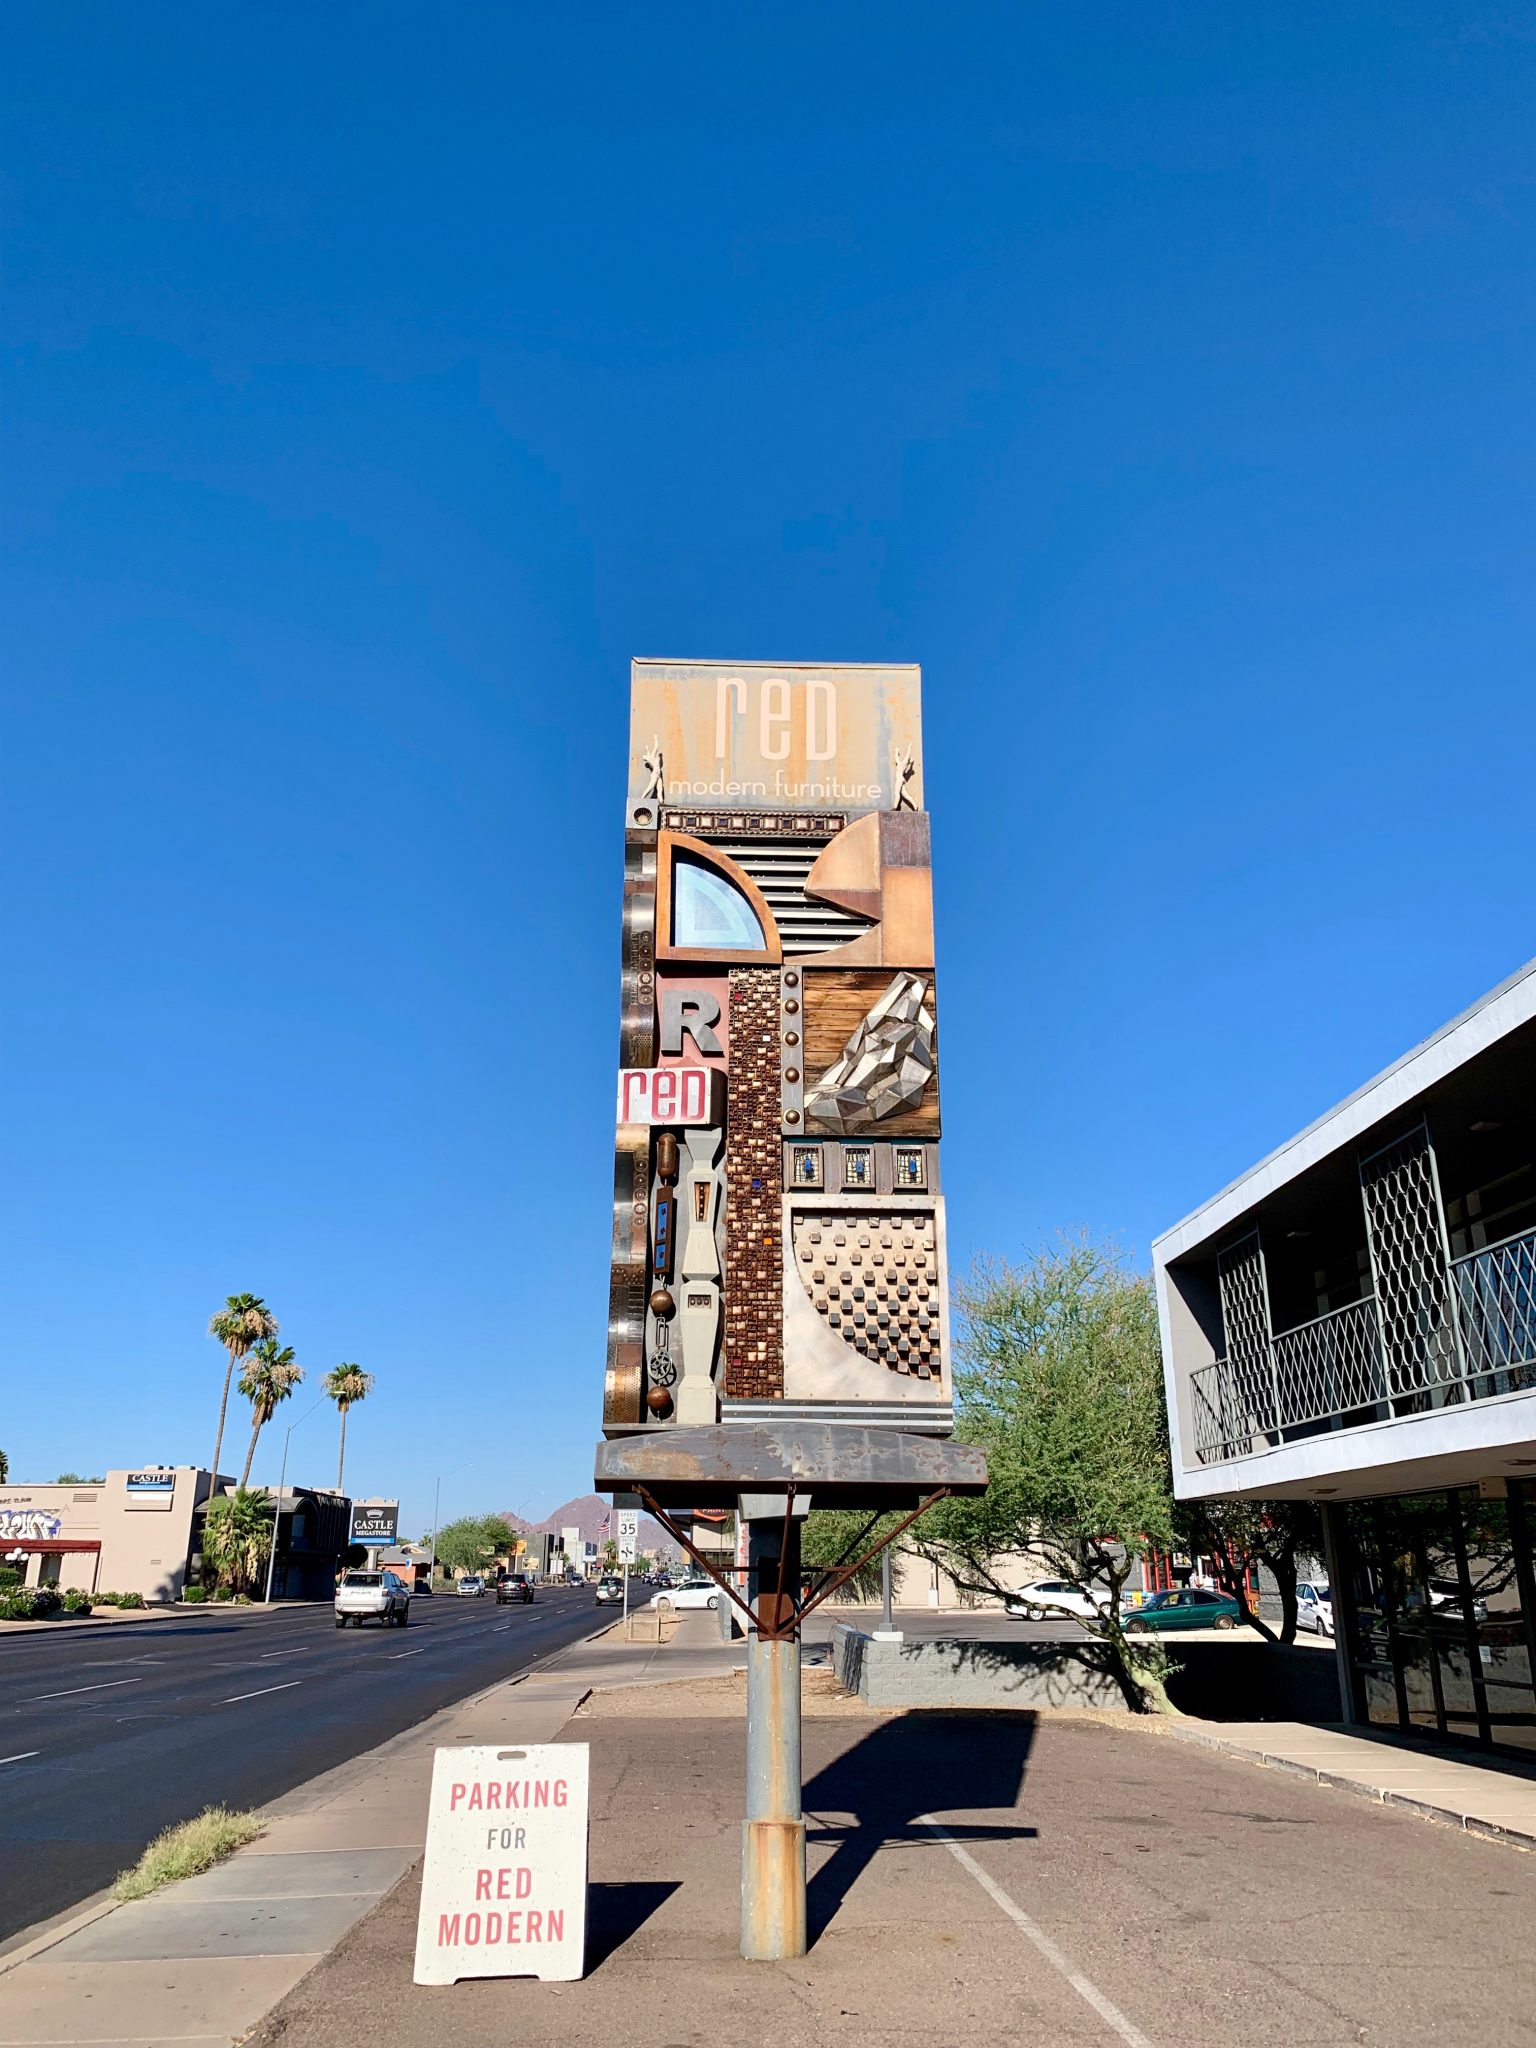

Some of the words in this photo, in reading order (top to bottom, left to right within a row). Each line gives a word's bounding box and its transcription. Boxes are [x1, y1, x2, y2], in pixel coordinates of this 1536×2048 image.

[669, 768, 766, 796] modern
[774, 769, 882, 798] furniture
[661, 990, 724, 1053] R
[132, 1474, 169, 1482] CASTLE
[354, 1519, 394, 1530] CASTLE
[620, 1523, 636, 1535] 35
[450, 1779, 568, 1811] PARKING
[487, 1827, 526, 1850] FOR
[475, 1867, 533, 1901] RED
[437, 1909, 564, 1947] MODERN
